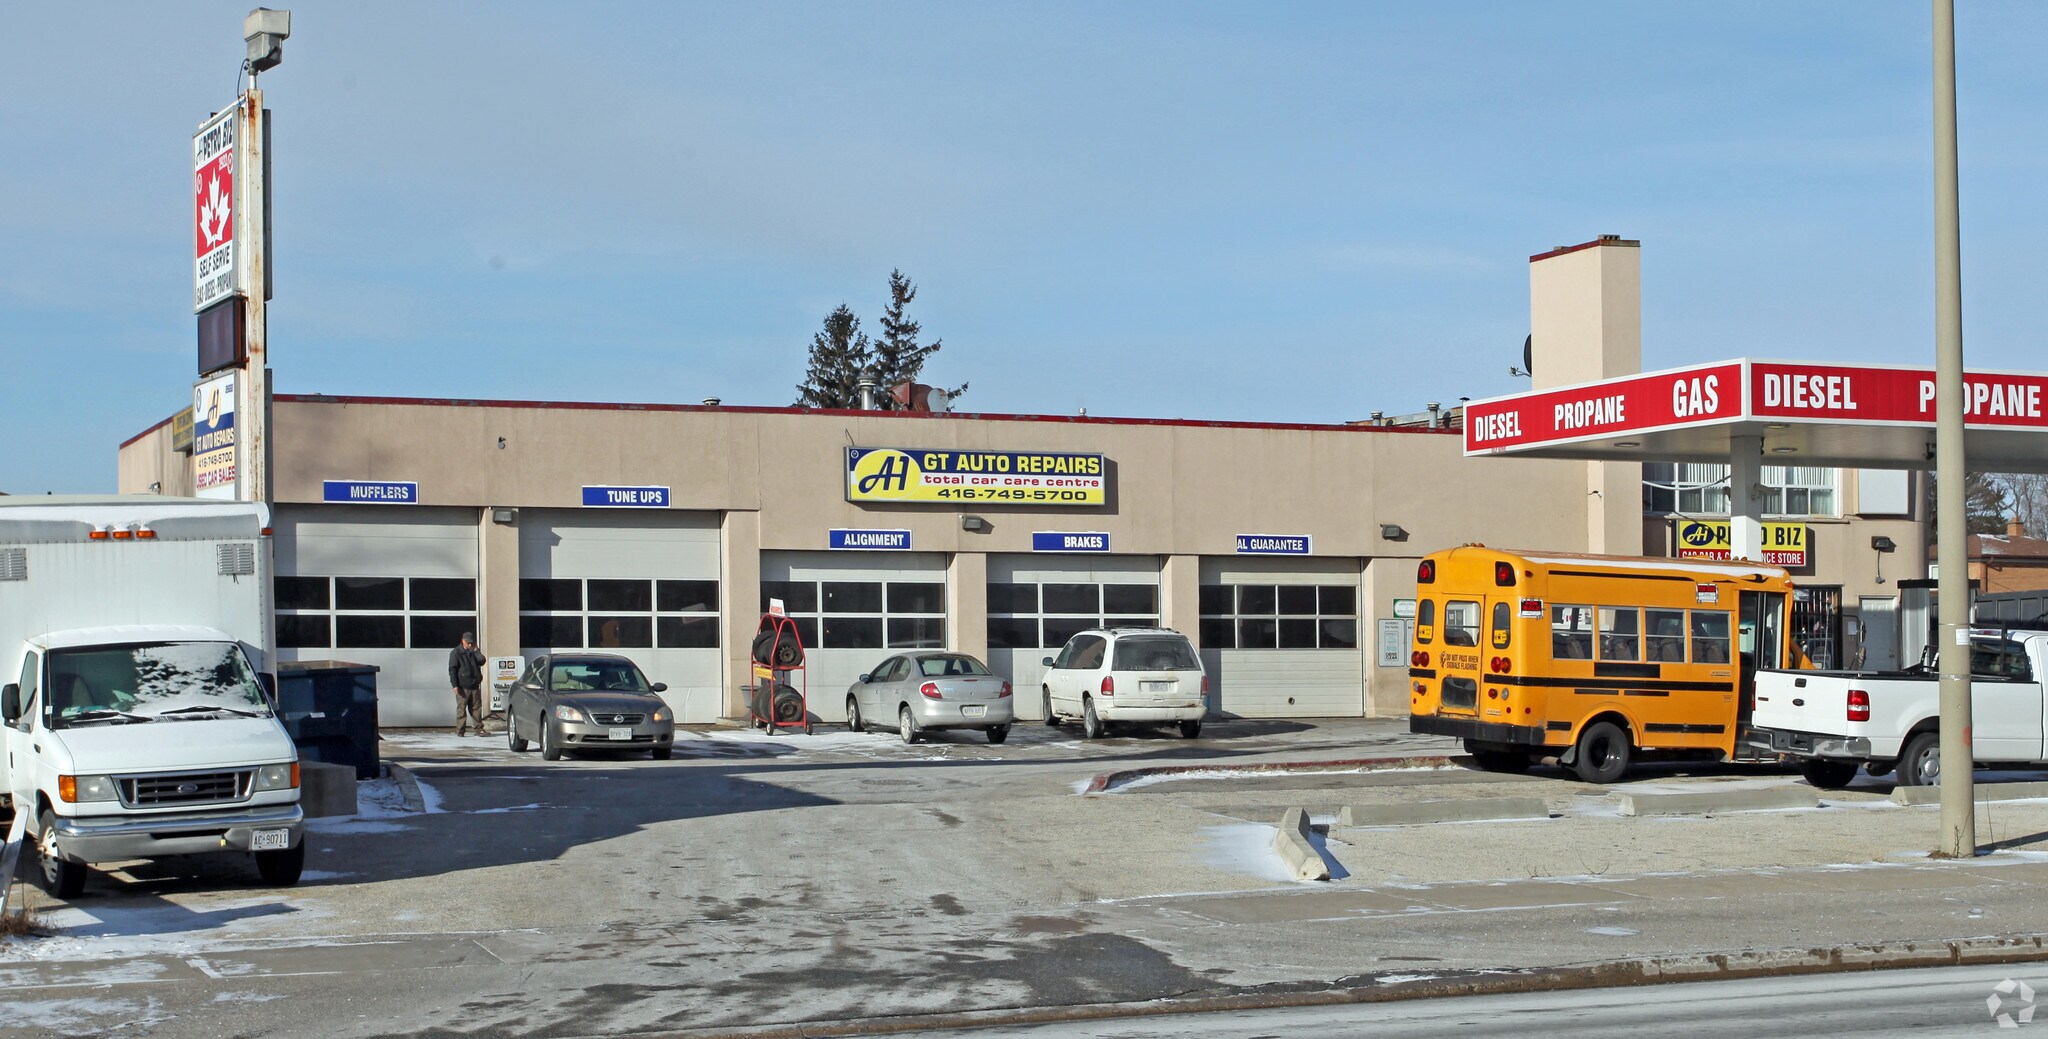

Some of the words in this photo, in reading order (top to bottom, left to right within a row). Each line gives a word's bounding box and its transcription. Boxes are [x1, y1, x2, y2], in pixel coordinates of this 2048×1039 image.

[203, 124, 221, 161] PETRO
[222, 118, 232, 148] BIZ
[200, 256, 212, 279] SELF
[213, 246, 230, 272] SERVE
[1764, 373, 1857, 410] DIESEL
[1475, 410, 1522, 442] DIESEL
[1554, 394, 1625, 431] PROPANE
[1672, 374, 1719, 418] GAS
[202, 432, 213, 450] AUTO
[214, 427, 235, 448] REPAIRS
[198, 451, 232, 468] 416-749-5700
[924, 453, 950, 471] GT
[956, 454, 1010, 472] AUTO
[1017, 456, 1100, 474] REPAIRS
[208, 470, 218, 486] CAR
[218, 465, 235, 482] SALES
[858, 455, 910, 494] A1
[924, 474, 964, 485] total
[971, 477, 998, 486] car
[1004, 478, 1042, 486] care
[1046, 478, 1100, 487] centre
[350, 486, 408, 499] MUFFLERS
[607, 490, 638, 503] TUNE
[640, 490, 662, 504] UPS
[938, 489, 1088, 501] 416-749-5700
[844, 534, 904, 546] ALIGNMENT
[1064, 536, 1103, 548] BRAKES
[1237, 538, 1248, 550] AL
[1250, 539, 1304, 550] GUARANTEE
[1776, 527, 1801, 546] BIZ
[1778, 552, 1802, 564] STORE
